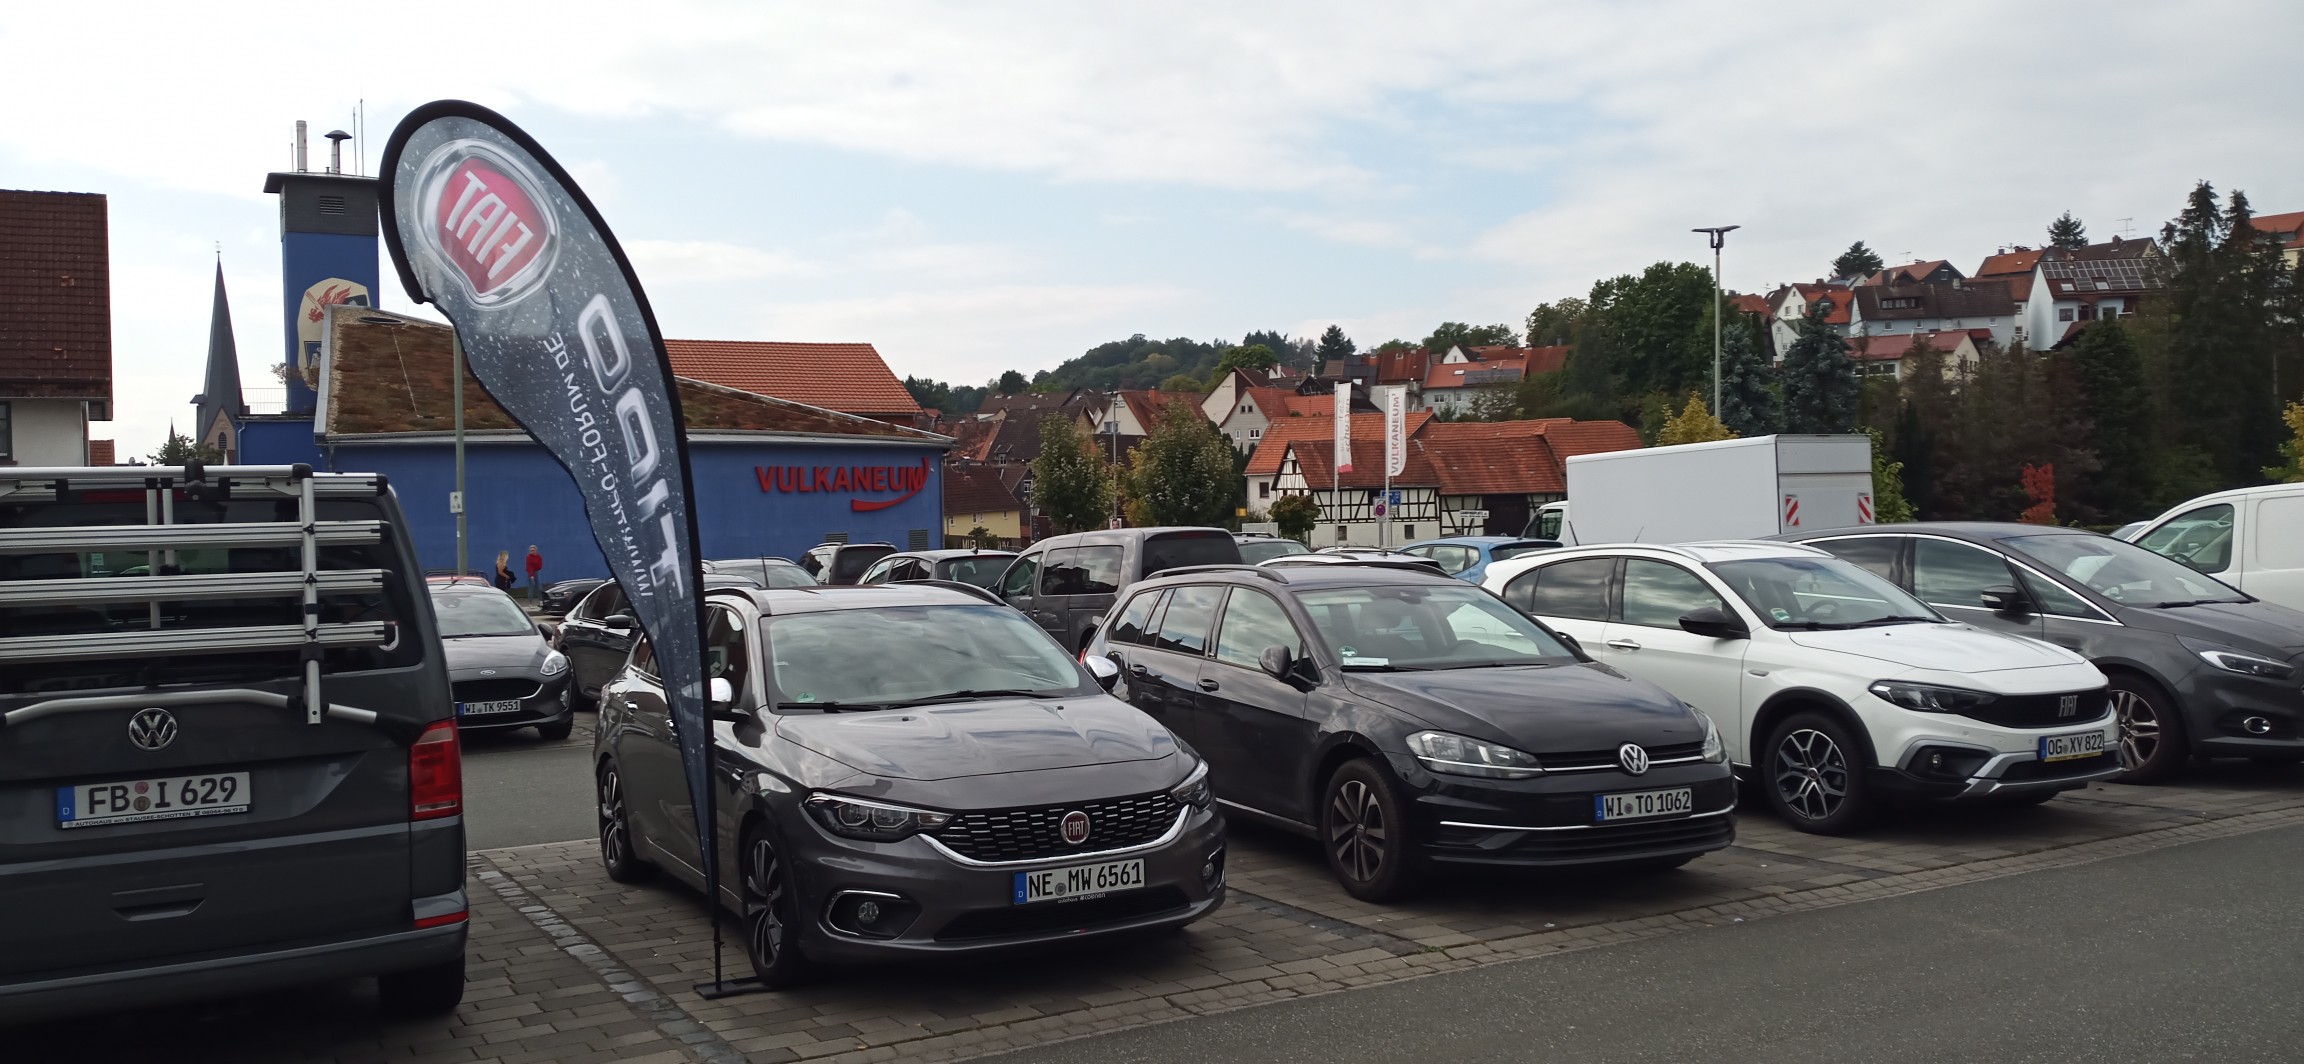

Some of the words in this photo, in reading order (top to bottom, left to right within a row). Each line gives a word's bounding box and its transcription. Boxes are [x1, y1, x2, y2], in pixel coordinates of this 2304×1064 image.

[1391, 396, 1400, 474] VULKANEUM
[755, 464, 928, 493] VULKANEUM
[465, 704, 476, 714] WI
[483, 702, 495, 712] TK
[496, 701, 519, 712] 9551
[2058, 694, 2078, 718] FIAT
[2048, 739, 2063, 755] OG
[2069, 736, 2085, 753] XY
[2085, 734, 2103, 750] 822
[88, 785, 131, 815] FB
[154, 781, 171, 808] I
[180, 776, 237, 806] 629
[1605, 797, 1623, 817] WI
[1635, 795, 1653, 814] TO
[1656, 791, 1690, 812] 1062
[1068, 820, 1085, 836] FIAT
[1028, 872, 1053, 898] NE
[1068, 867, 1092, 893] MW
[1097, 861, 1142, 889] 6561
